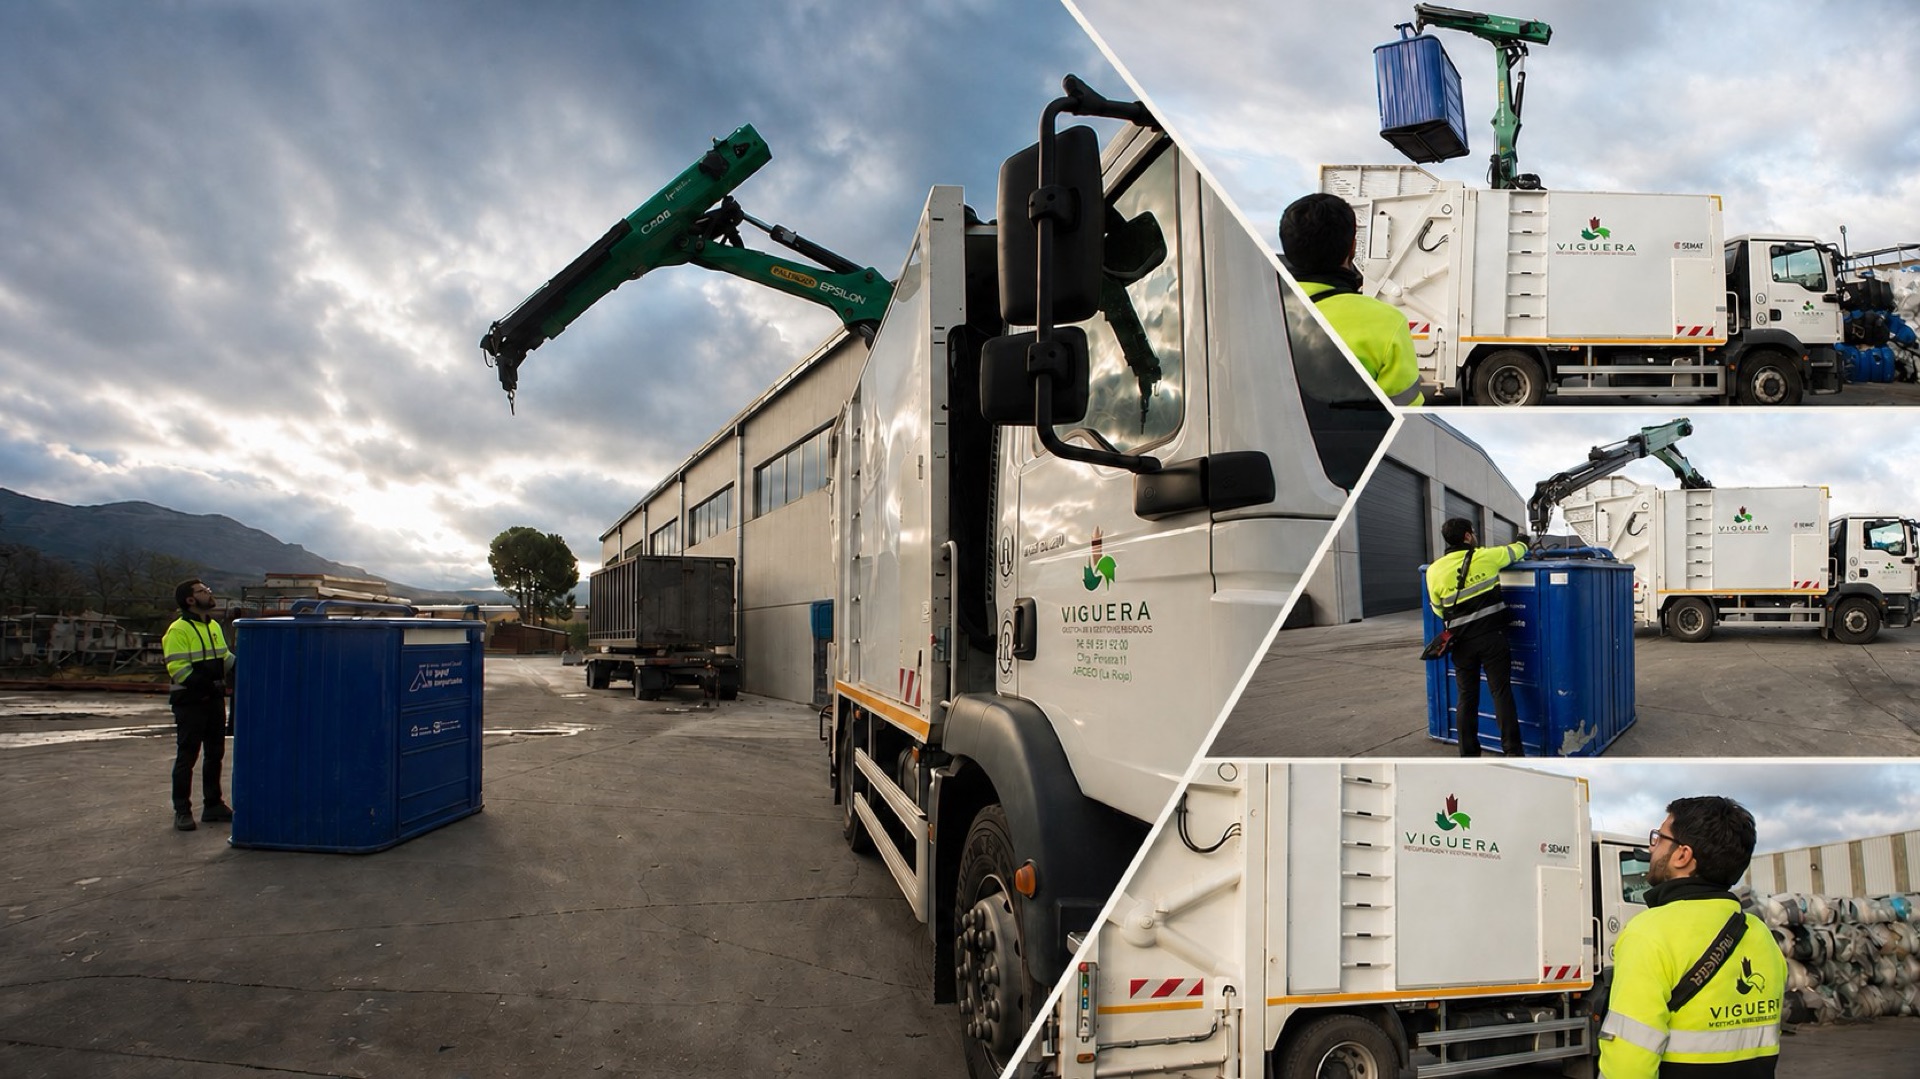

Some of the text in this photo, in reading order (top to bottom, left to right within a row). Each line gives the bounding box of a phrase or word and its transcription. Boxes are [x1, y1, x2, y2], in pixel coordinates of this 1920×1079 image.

[1556, 243, 1636, 252] VIGUERA
[819, 281, 866, 304] EPSILON
[1061, 601, 1151, 623] VIGUERA
[1405, 832, 1500, 853] VIGUERA
